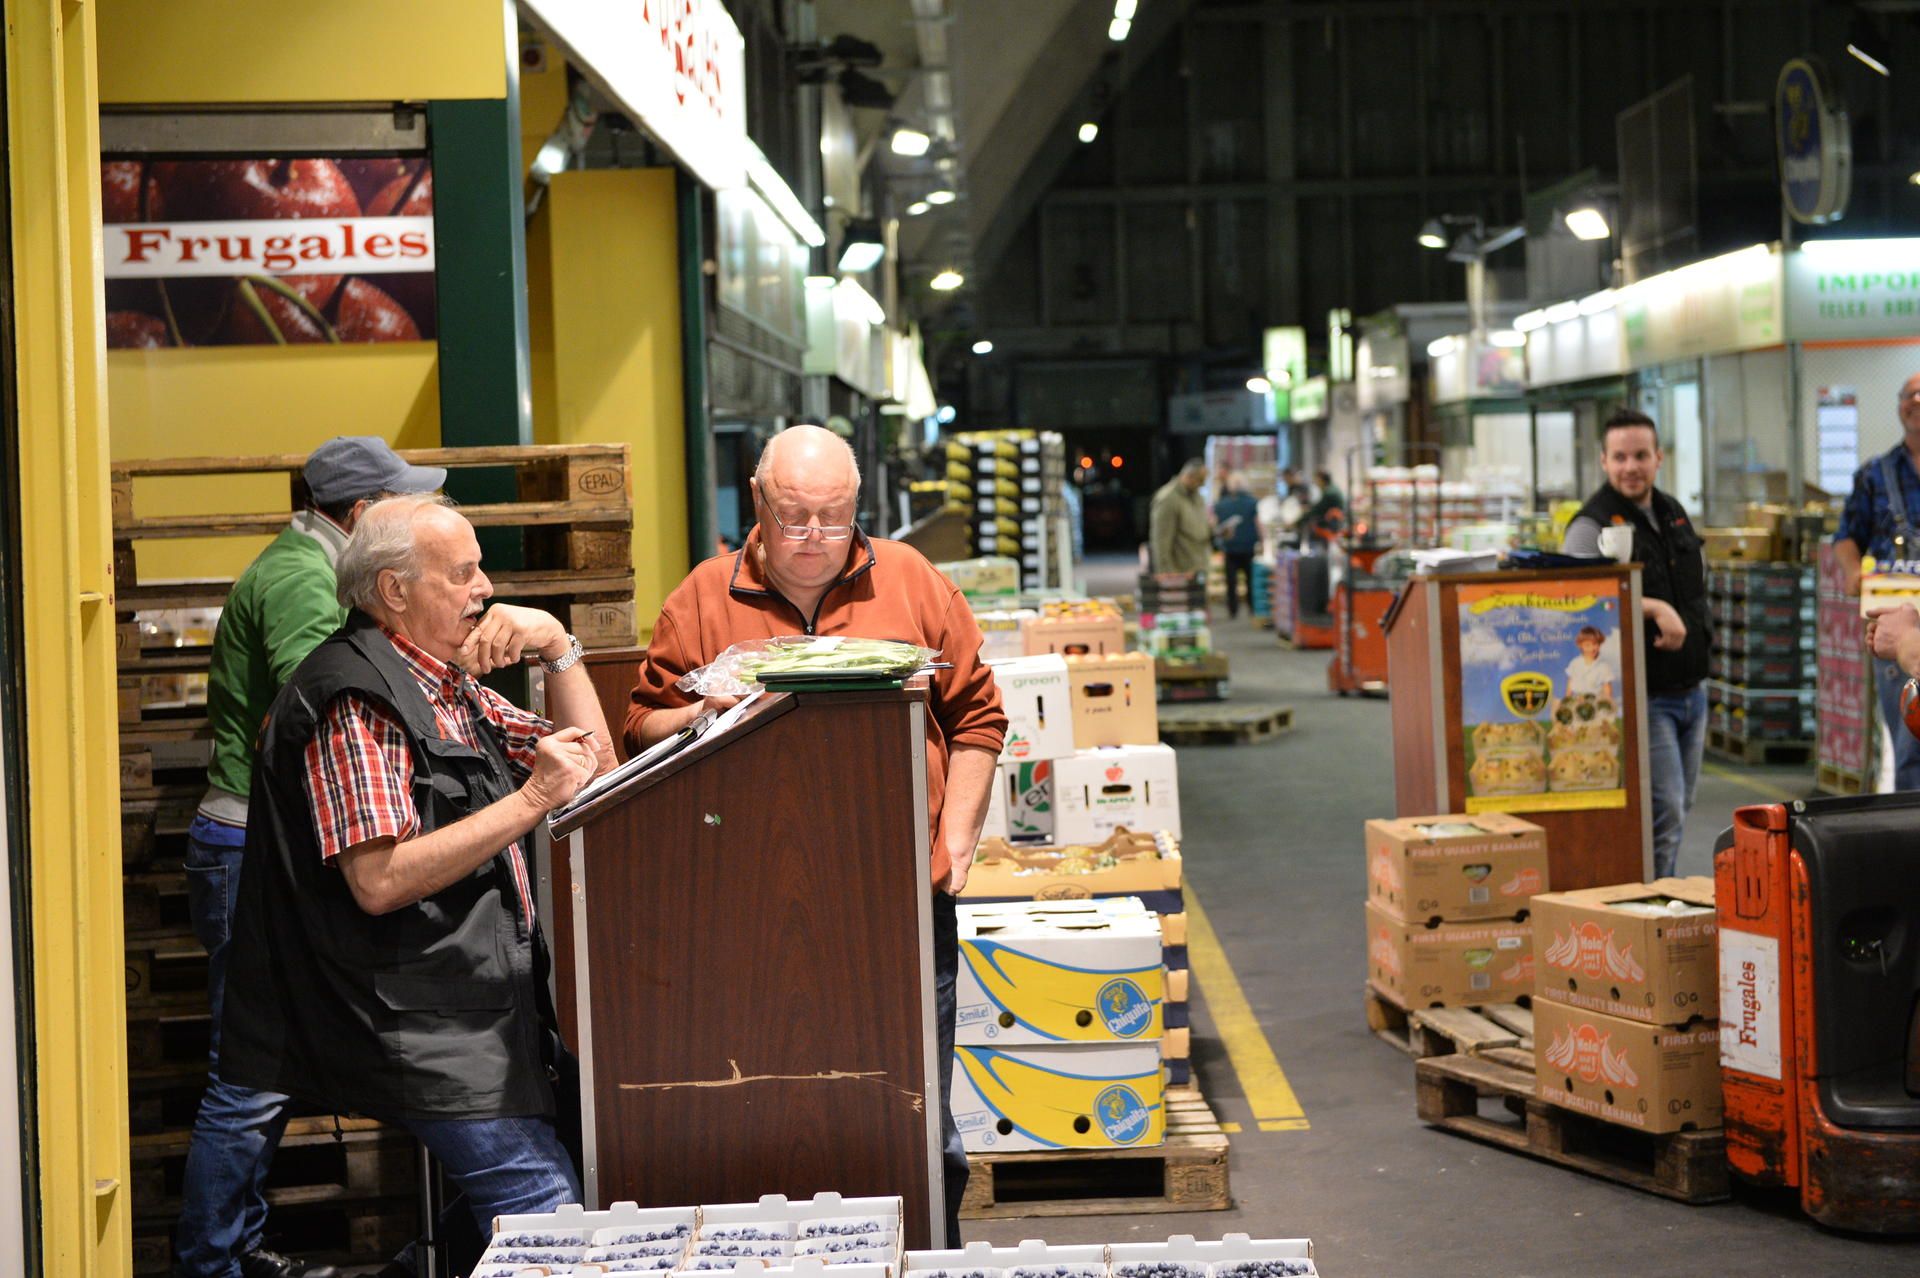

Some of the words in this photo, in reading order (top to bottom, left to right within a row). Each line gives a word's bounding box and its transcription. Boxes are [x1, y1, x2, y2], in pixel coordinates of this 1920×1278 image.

[121, 224, 430, 273] Frugales
[1013, 674, 1062, 690] green
[1412, 847, 1442, 858] FIRST
[1445, 844, 1489, 856] QUALITY
[1492, 840, 1541, 853] BANANAS
[1412, 933, 1442, 943] FIRST
[1445, 930, 1488, 941] QUALITY
[1666, 925, 1699, 939] FIRST
[1737, 960, 1761, 1048] Frugales
[1106, 1001, 1150, 1033] Chiquita
[1662, 1033, 1695, 1047] FIRST
[1105, 1108, 1149, 1139] Chiquita
[1601, 1101, 1645, 1126] BANANAS
